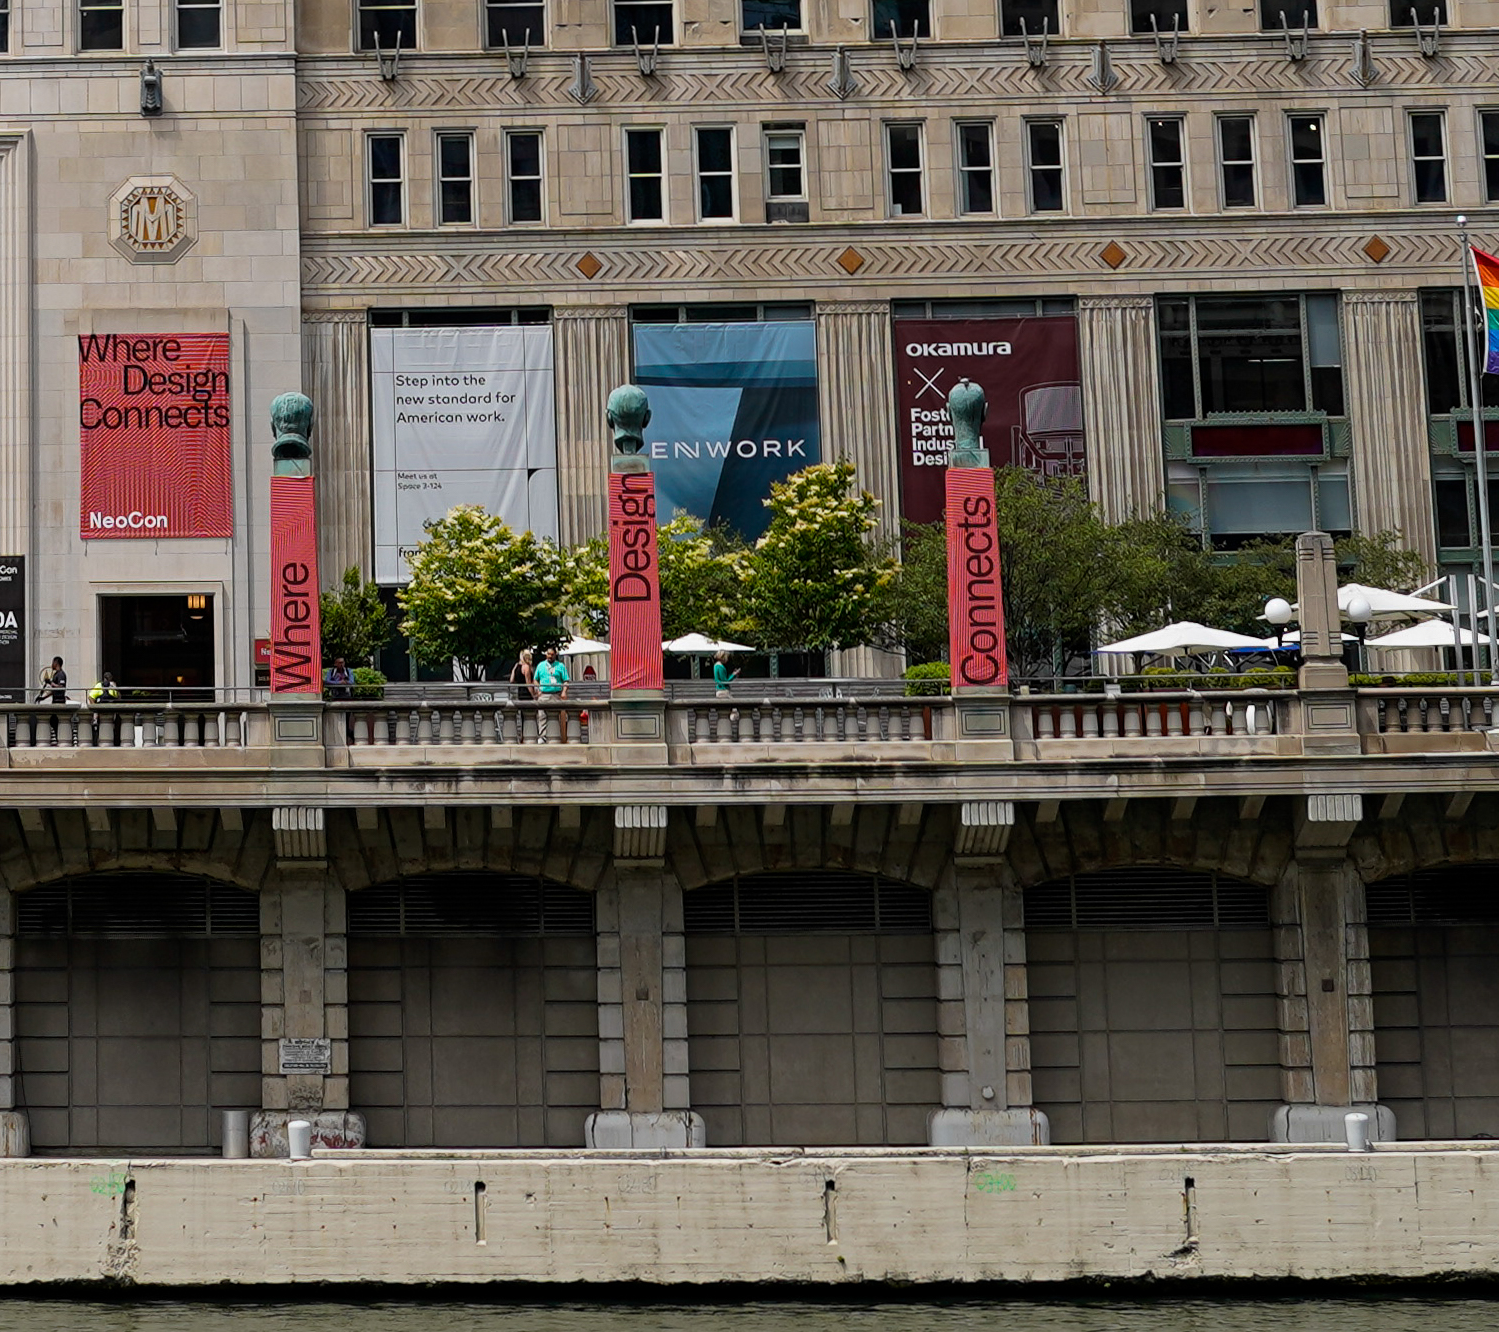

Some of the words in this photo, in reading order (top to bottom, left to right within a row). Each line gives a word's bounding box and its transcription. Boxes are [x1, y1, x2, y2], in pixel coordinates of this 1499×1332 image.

[78, 334, 181, 362] Where
[905, 341, 1012, 356] okamura
[124, 364, 229, 403] Design
[395, 374, 429, 388] Step
[432, 374, 460, 387] into
[463, 374, 486, 386] the
[396, 395, 424, 405] new
[428, 392, 492, 405] standard
[495, 391, 516, 404] for
[80, 398, 230, 429] Connects
[396, 411, 463, 424] American
[466, 410, 506, 423] work.
[910, 407, 952, 422] Fost
[911, 422, 954, 436] Partn
[913, 451, 949, 466] Desi
[397, 472, 418, 480] Meet
[397, 482, 421, 490] Space
[89, 511, 168, 529] NeoCon
[613, 472, 655, 602] Design
[957, 496, 999, 685] Connects
[274, 562, 312, 692] Where
